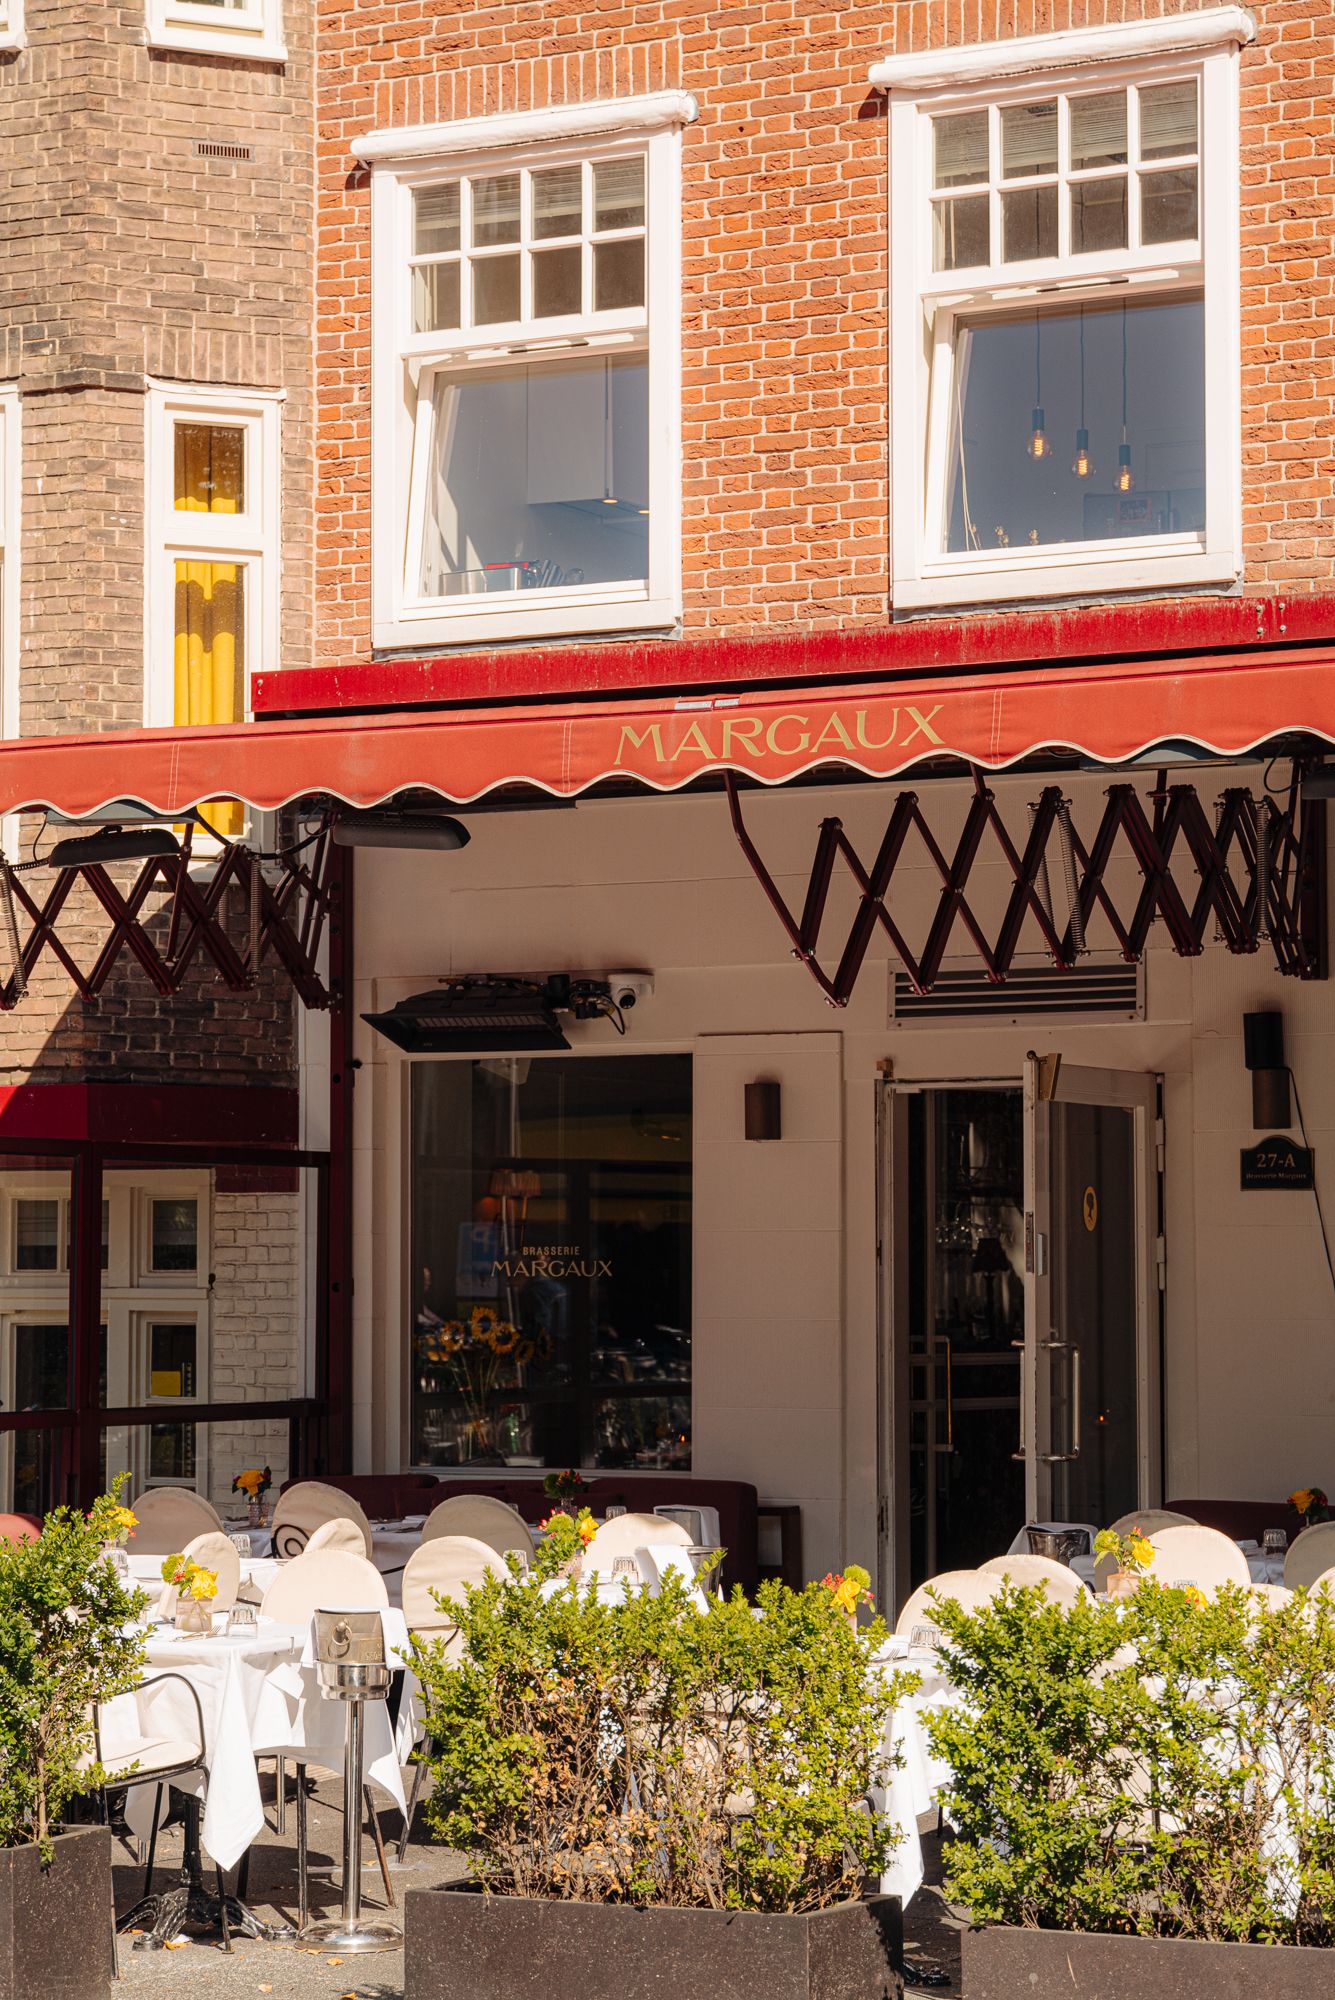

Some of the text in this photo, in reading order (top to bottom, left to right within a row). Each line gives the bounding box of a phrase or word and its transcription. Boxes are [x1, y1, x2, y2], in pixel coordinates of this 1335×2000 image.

[613, 704, 946, 766] MARGAUX
[1256, 1152, 1296, 1168] 27-A
[522, 1246, 581, 1256] BRASSERIE
[490, 1260, 613, 1278] MARGAUX
